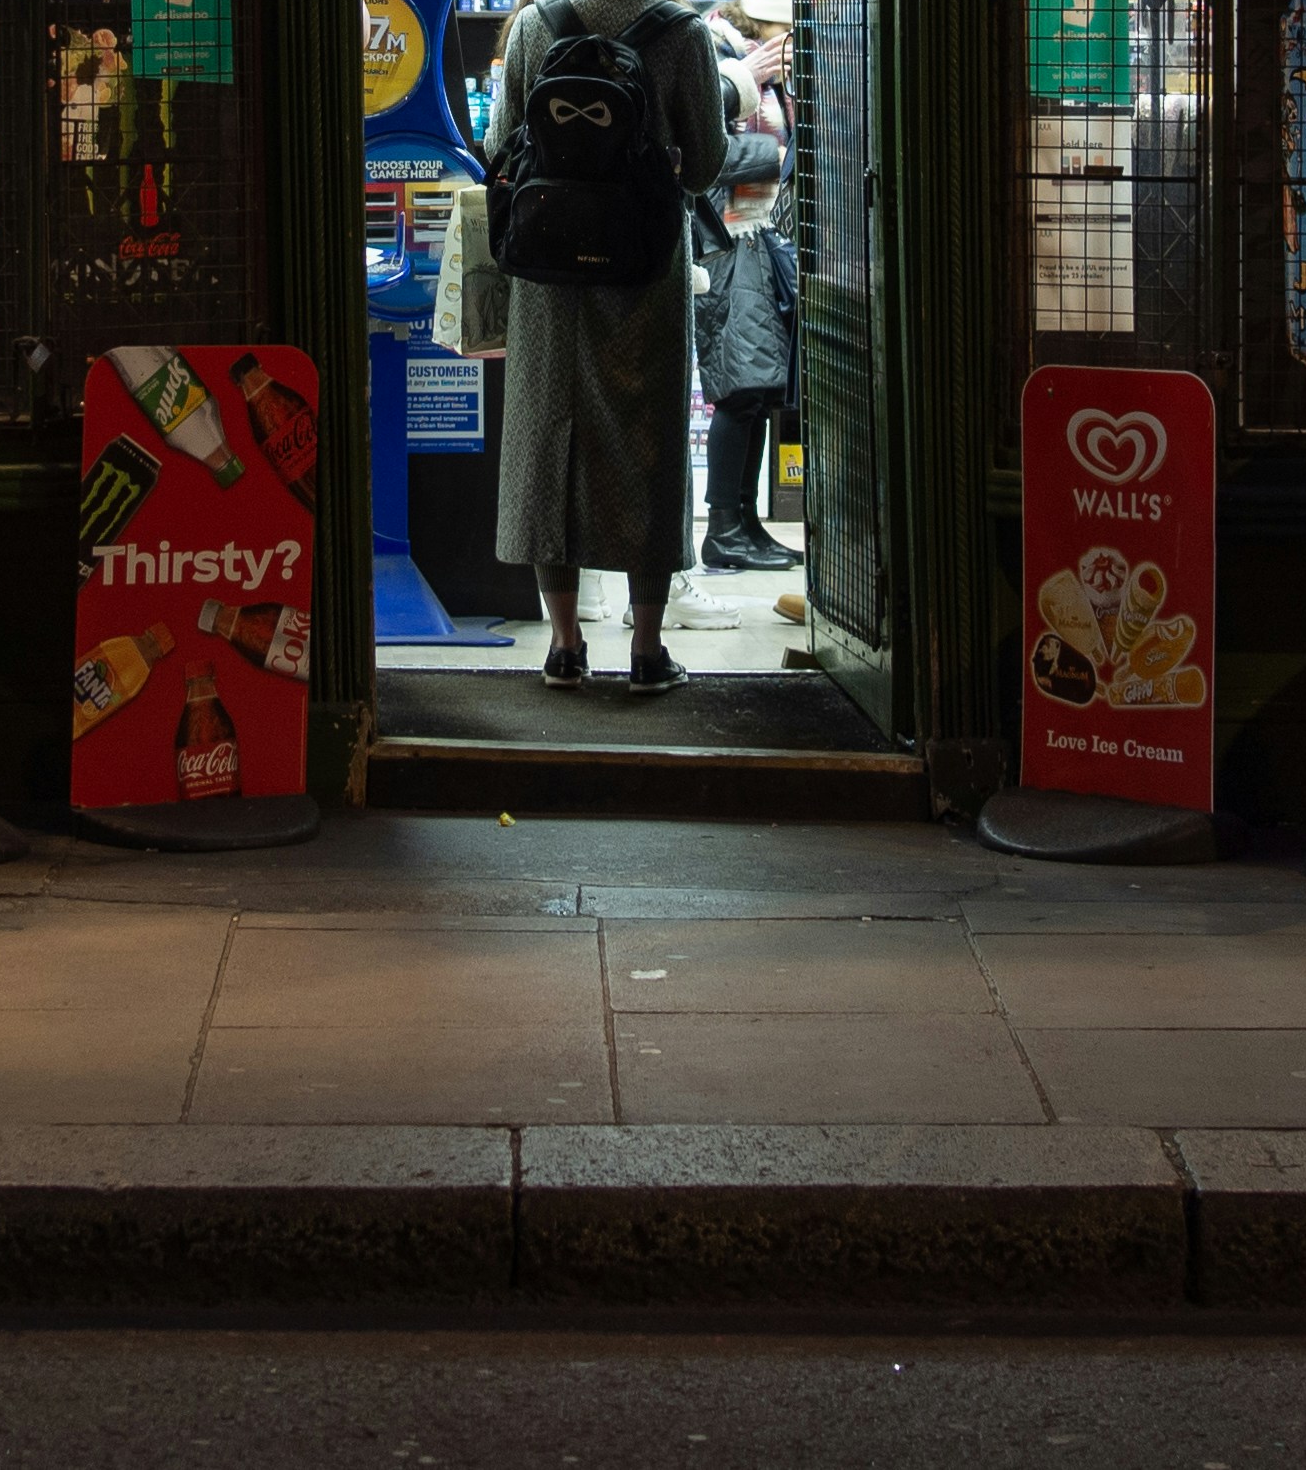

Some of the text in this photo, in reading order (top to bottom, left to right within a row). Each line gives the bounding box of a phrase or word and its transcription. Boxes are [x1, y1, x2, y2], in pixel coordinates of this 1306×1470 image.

[363, 53, 398, 63] CKPOT
[365, 160, 443, 170] CHOOSE YOUR
[370, 169, 439, 179] GAMES HERE
[408, 365, 478, 379] CUSTOMERS
[457, 379, 478, 389] please
[156, 356, 191, 426] Sprite
[1073, 488, 1163, 521] WALL'S
[93, 539, 301, 590] Thirsty?
[74, 661, 112, 709] FANTA
[178, 742, 237, 782] Coca-Cola
[1046, 729, 1184, 763] Love Ice Cream
